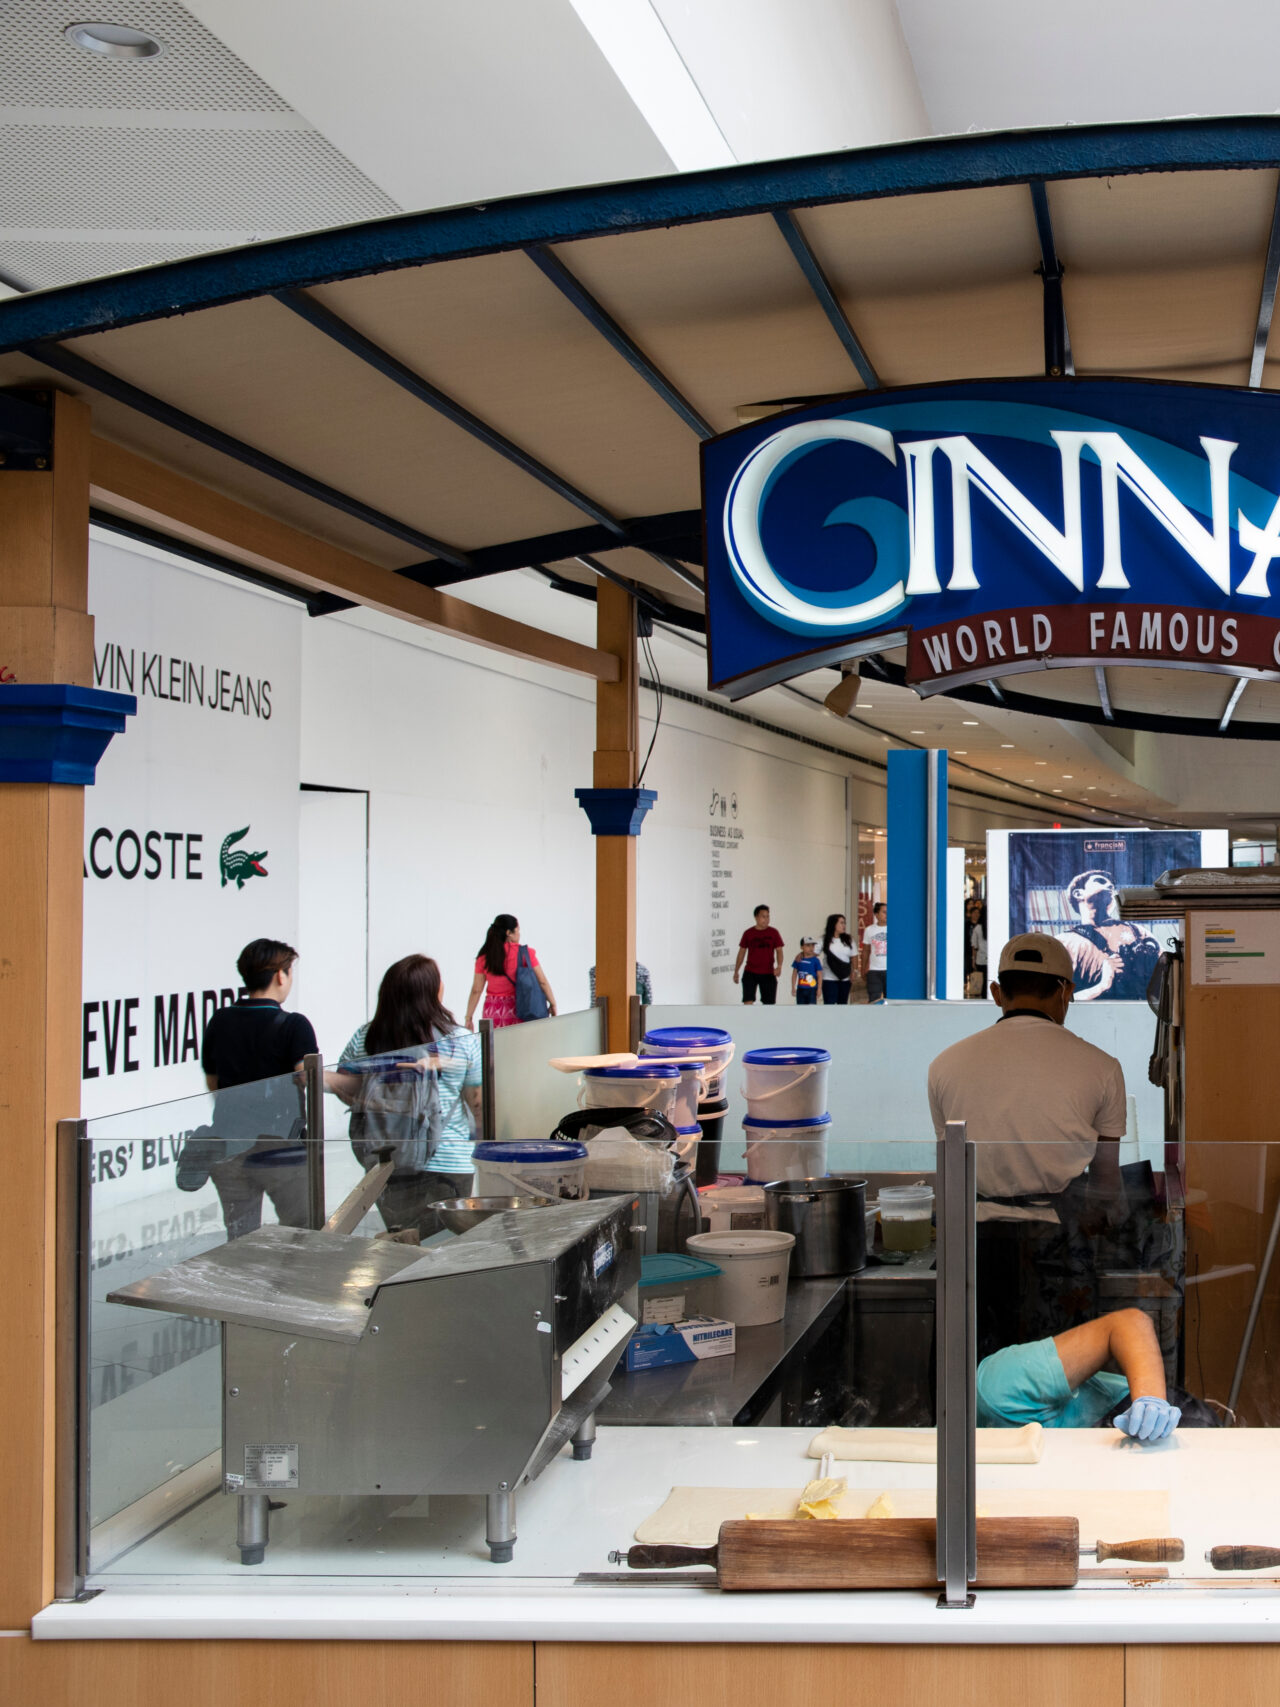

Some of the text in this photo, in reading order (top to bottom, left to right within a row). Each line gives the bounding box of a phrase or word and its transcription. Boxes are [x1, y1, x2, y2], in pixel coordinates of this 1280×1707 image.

[923, 613, 1052, 674] WORLD
[1089, 611, 1239, 657] FAMOUS
[142, 652, 204, 706] KLEIN
[207, 669, 272, 720] JEANS
[83, 827, 203, 880] COSTE
[692, 1328, 733, 1342] NITRILECARE
